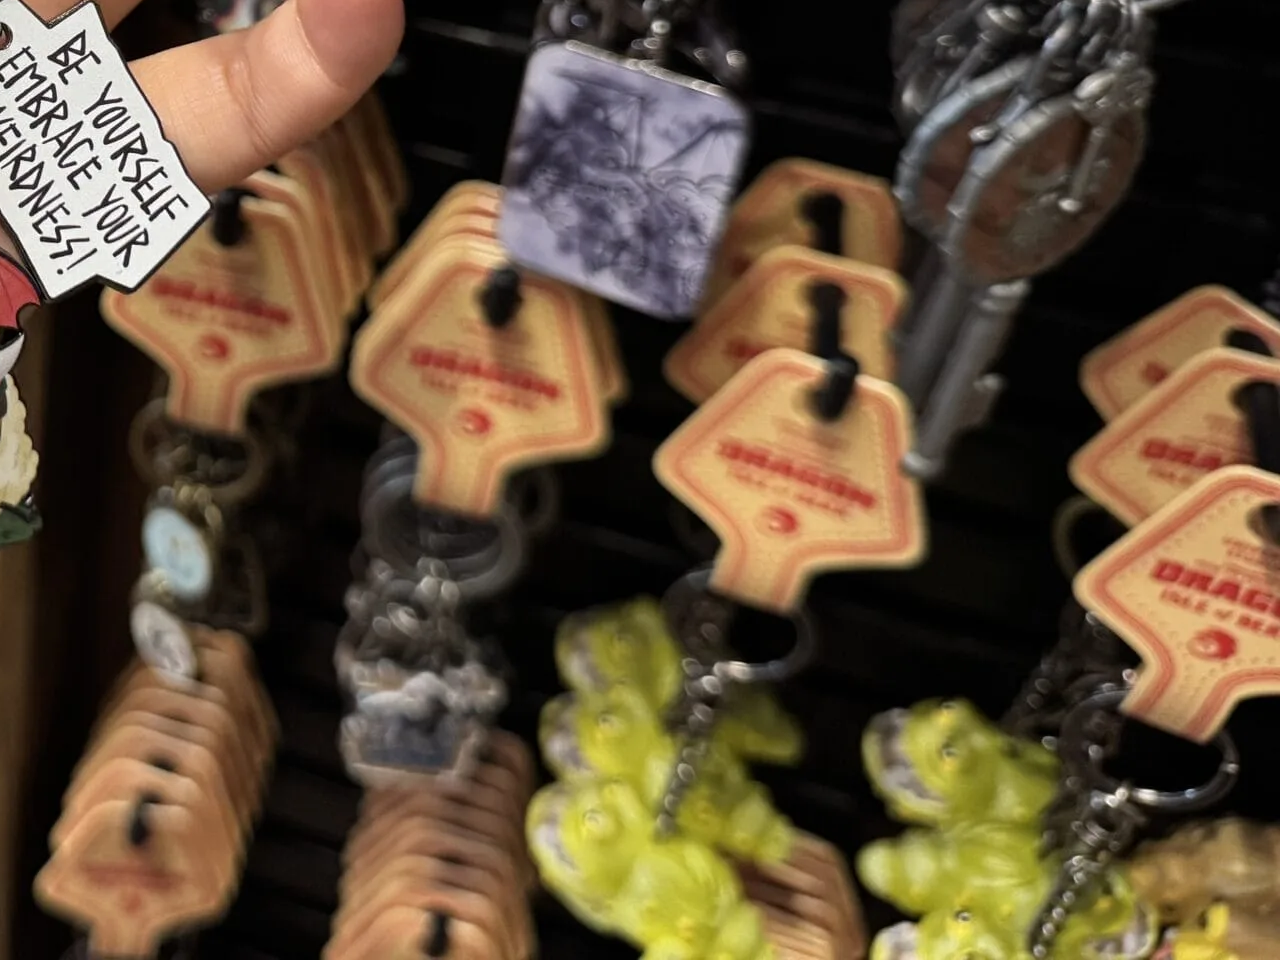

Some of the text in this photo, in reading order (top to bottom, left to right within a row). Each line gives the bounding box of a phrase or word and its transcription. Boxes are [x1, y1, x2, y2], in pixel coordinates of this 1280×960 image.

[47, 29, 189, 221] BE YOURSELF
[82, 183, 149, 268] YOUR
